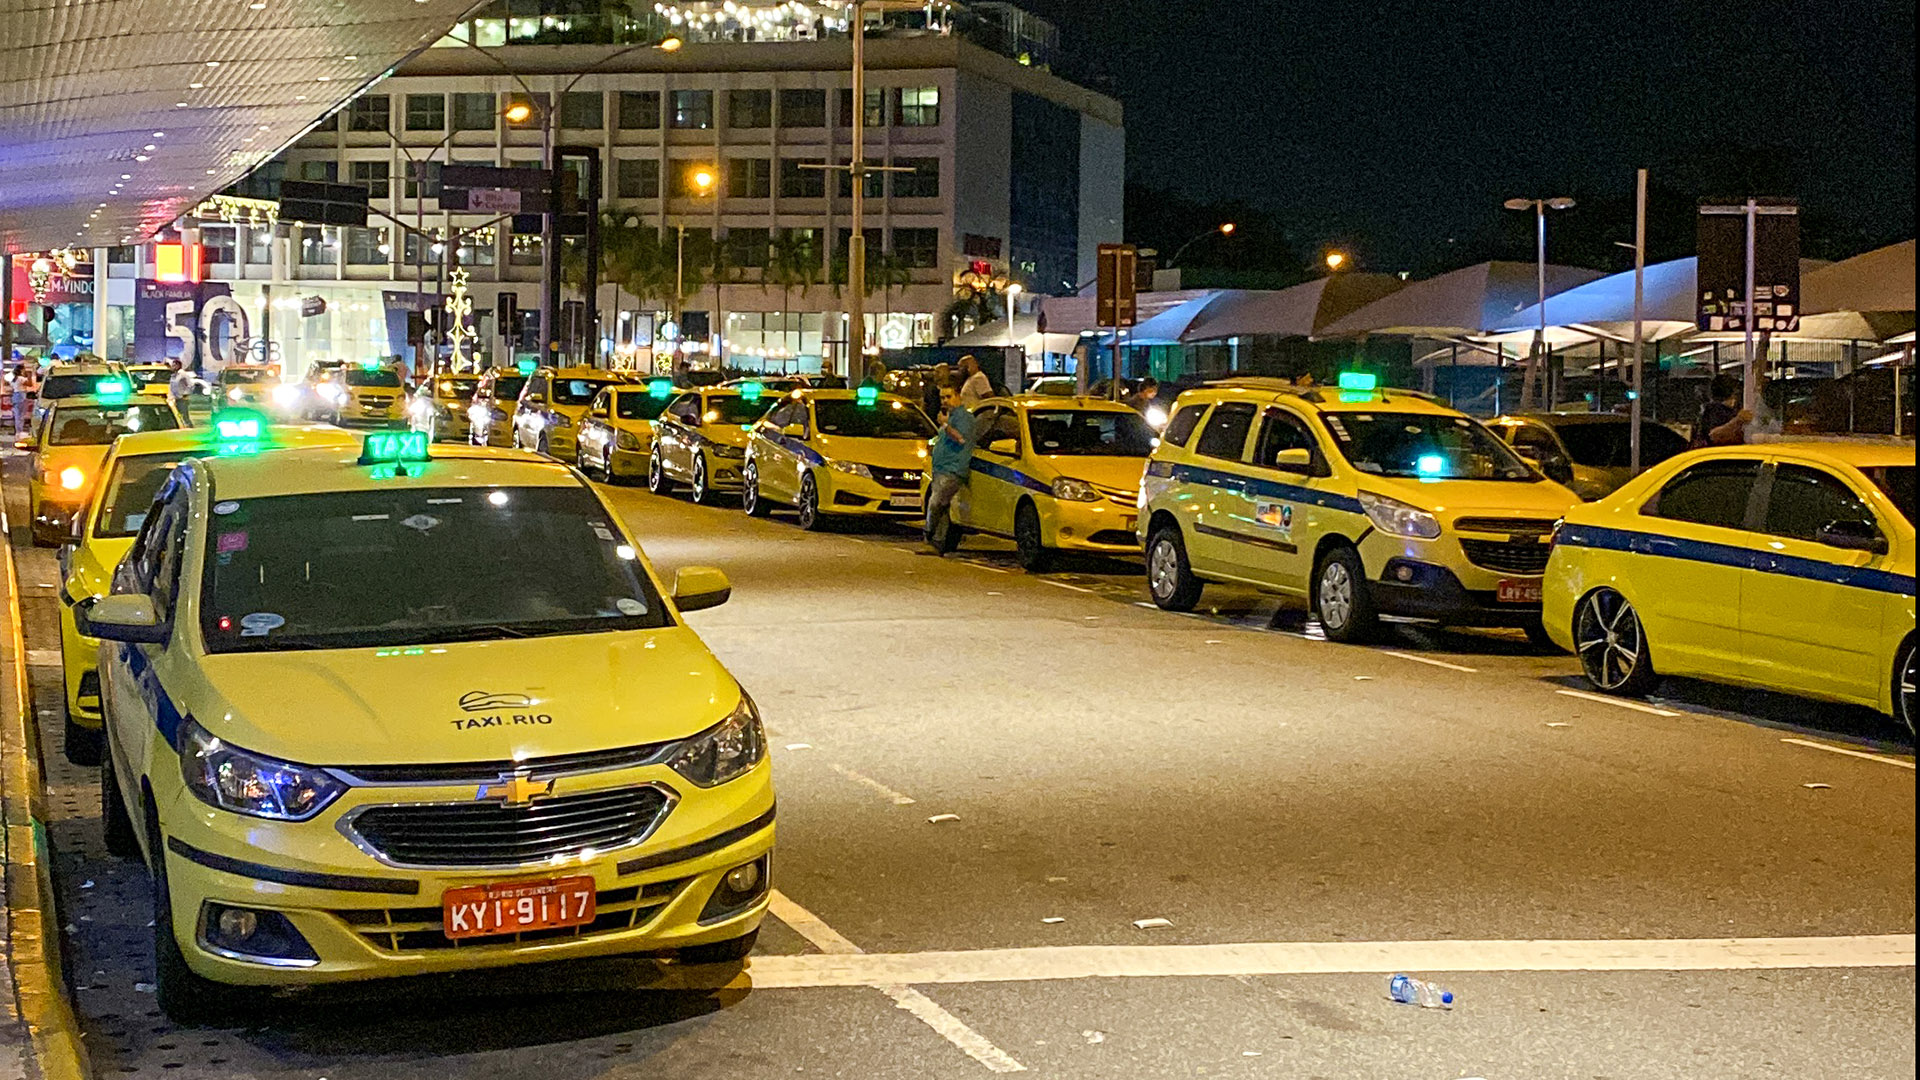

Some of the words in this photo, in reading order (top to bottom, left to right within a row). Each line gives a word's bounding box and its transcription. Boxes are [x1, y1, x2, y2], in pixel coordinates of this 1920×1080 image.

[45, 280, 94, 294] M-VINDO
[165, 295, 249, 373] 50
[368, 433, 424, 457] TAXI
[450, 714, 553, 730] TAXI.RIO
